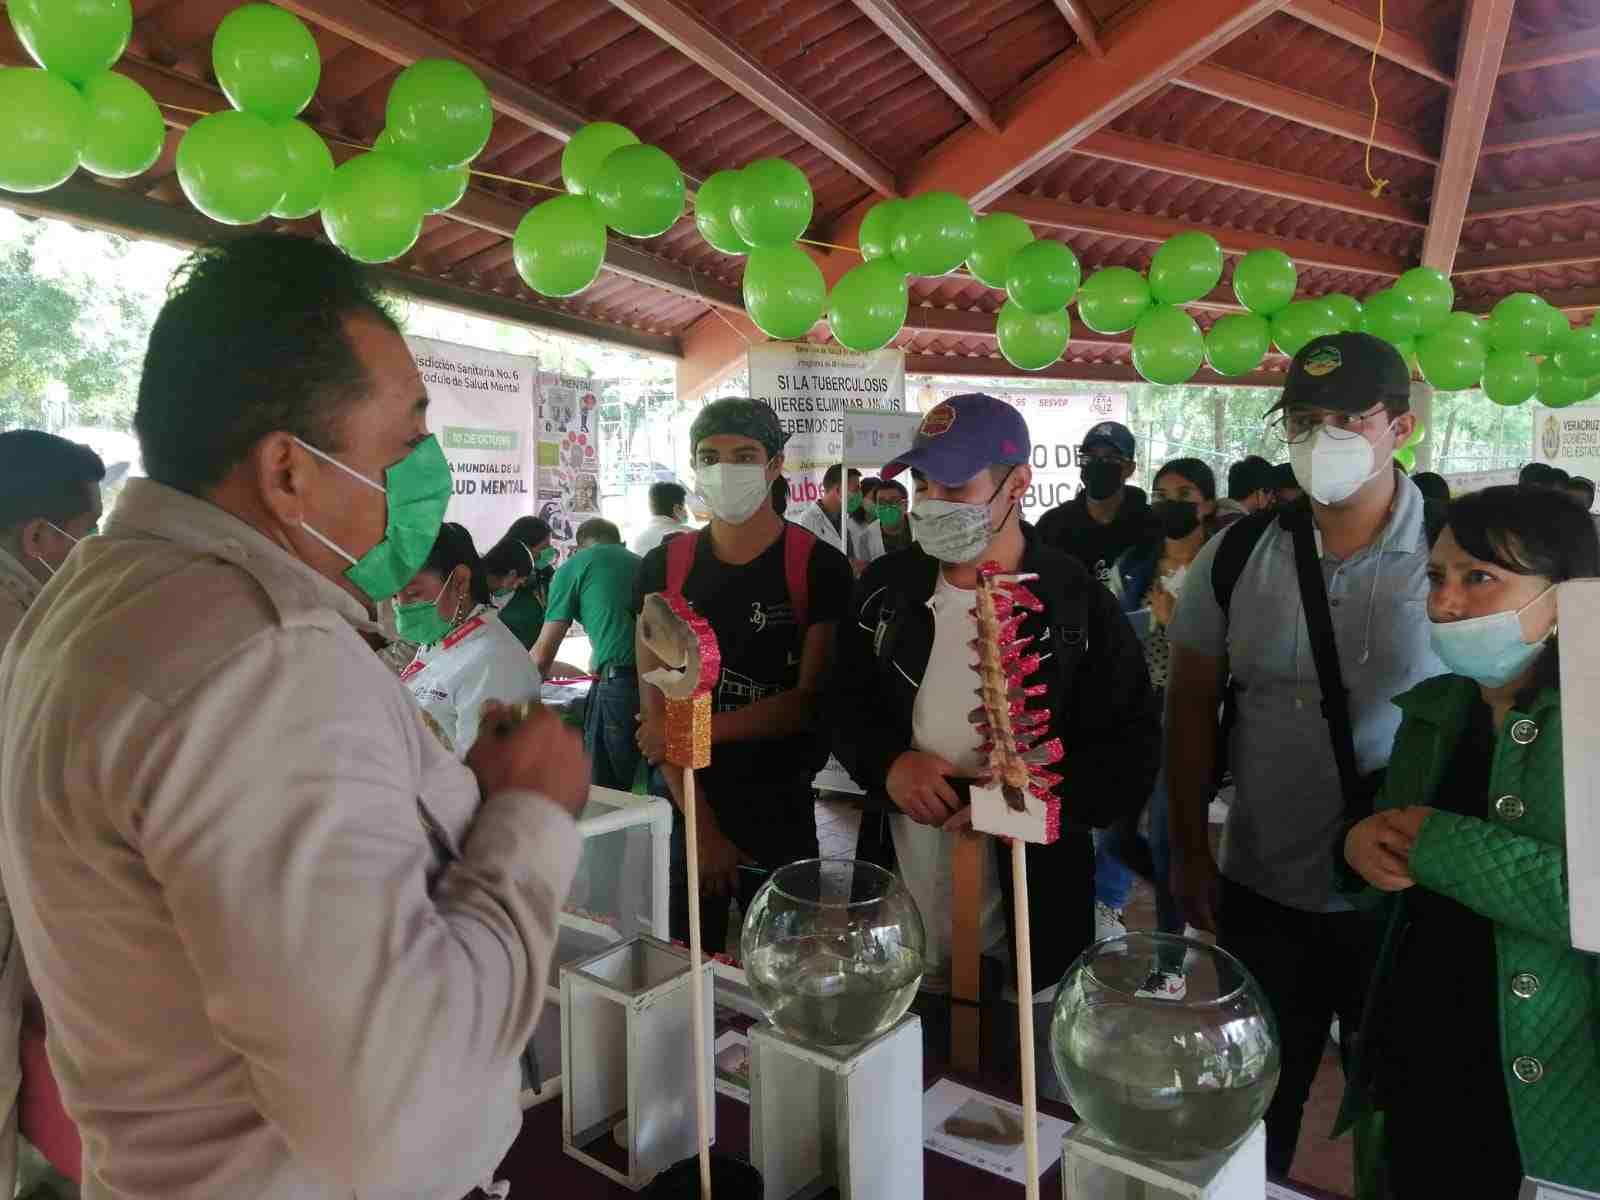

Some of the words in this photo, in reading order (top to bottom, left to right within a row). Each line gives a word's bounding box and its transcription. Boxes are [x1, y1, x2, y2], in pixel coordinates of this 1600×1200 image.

[465, 378, 489, 390] Salud
[777, 375, 790, 390] SI
[793, 375, 809, 391] LA
[812, 376, 888, 392] TUBERCULOSIS
[779, 418, 828, 433] EBEMOS
[457, 462, 500, 473] MUNDIAL
[501, 463, 511, 474] DE
[452, 480, 476, 495] UD
[481, 480, 528, 495] MENTAL
